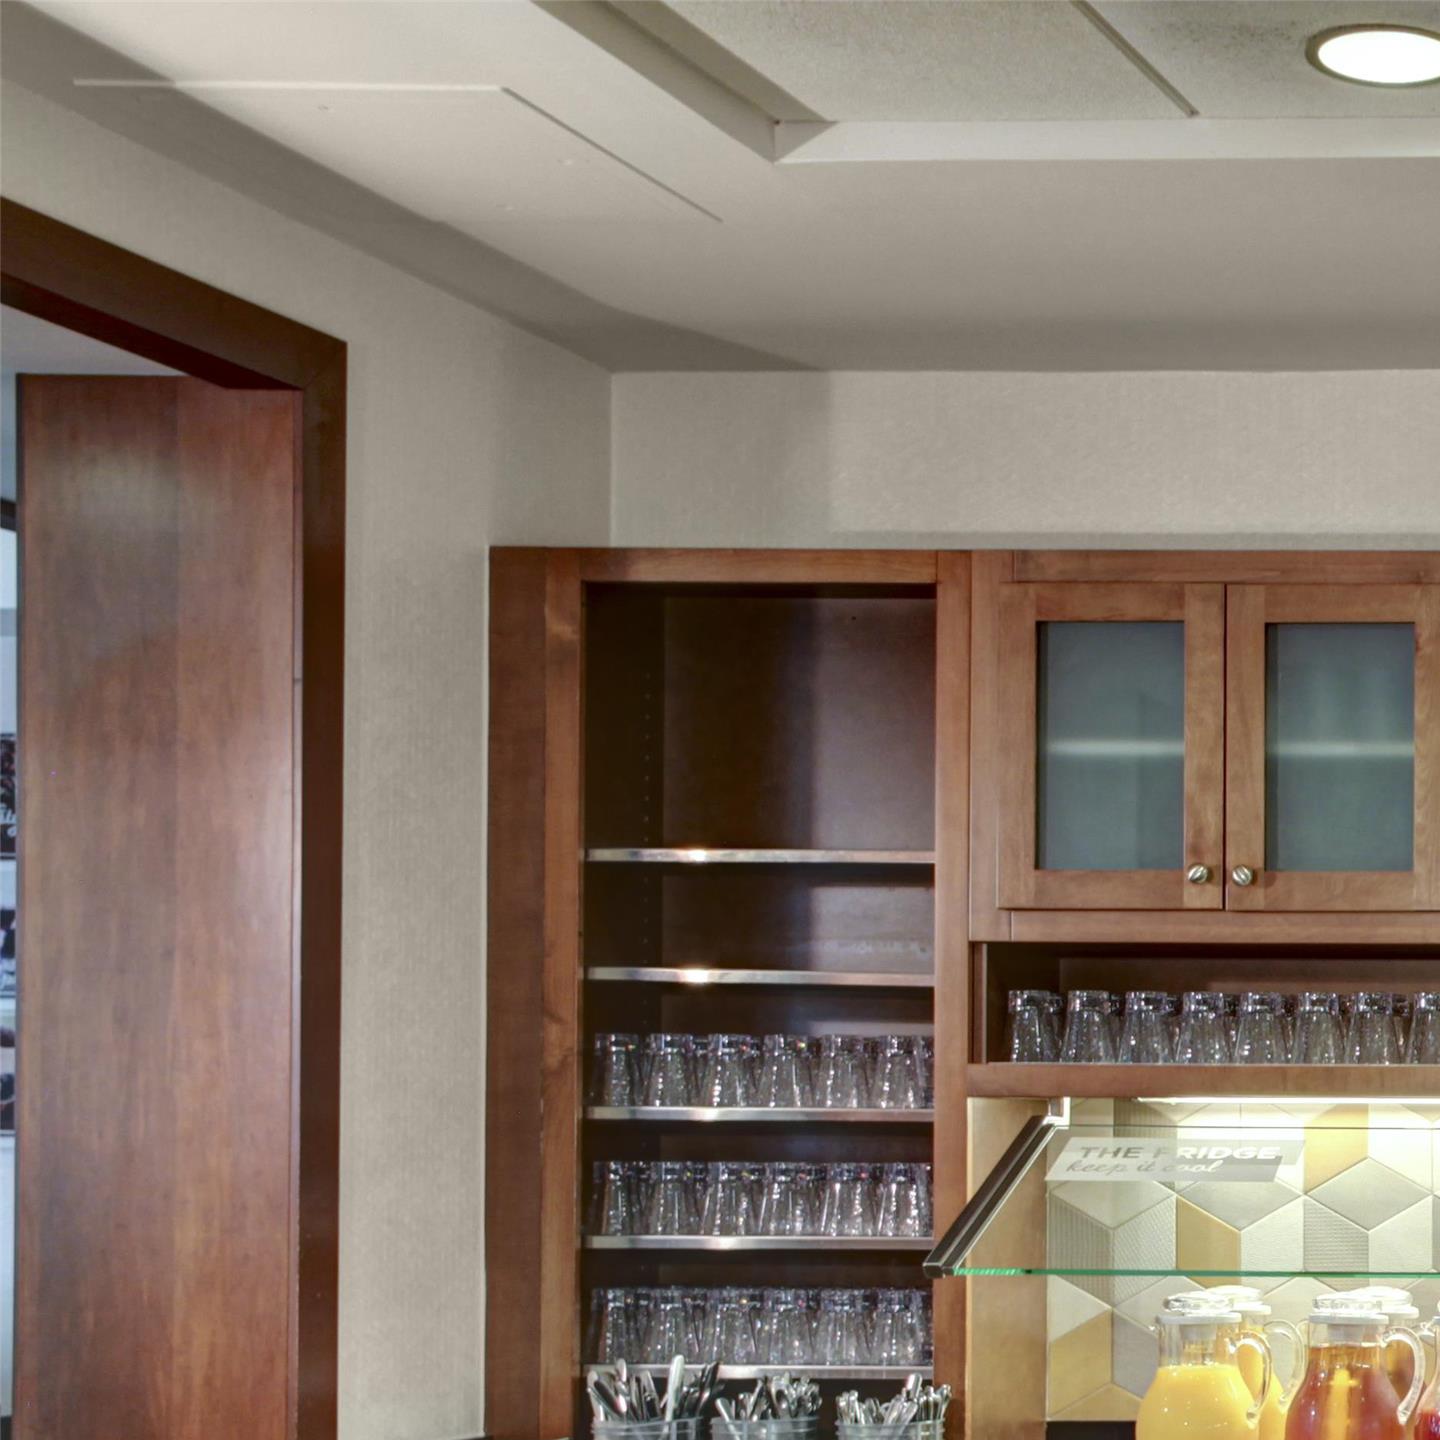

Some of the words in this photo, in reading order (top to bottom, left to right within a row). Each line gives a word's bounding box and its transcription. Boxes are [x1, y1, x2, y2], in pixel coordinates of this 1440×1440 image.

[1080, 1146, 1143, 1160] THE
[1151, 1146, 1282, 1160] FRIDGE
[1065, 1159, 1128, 1176] keep
[1137, 1160, 1157, 1174] it
